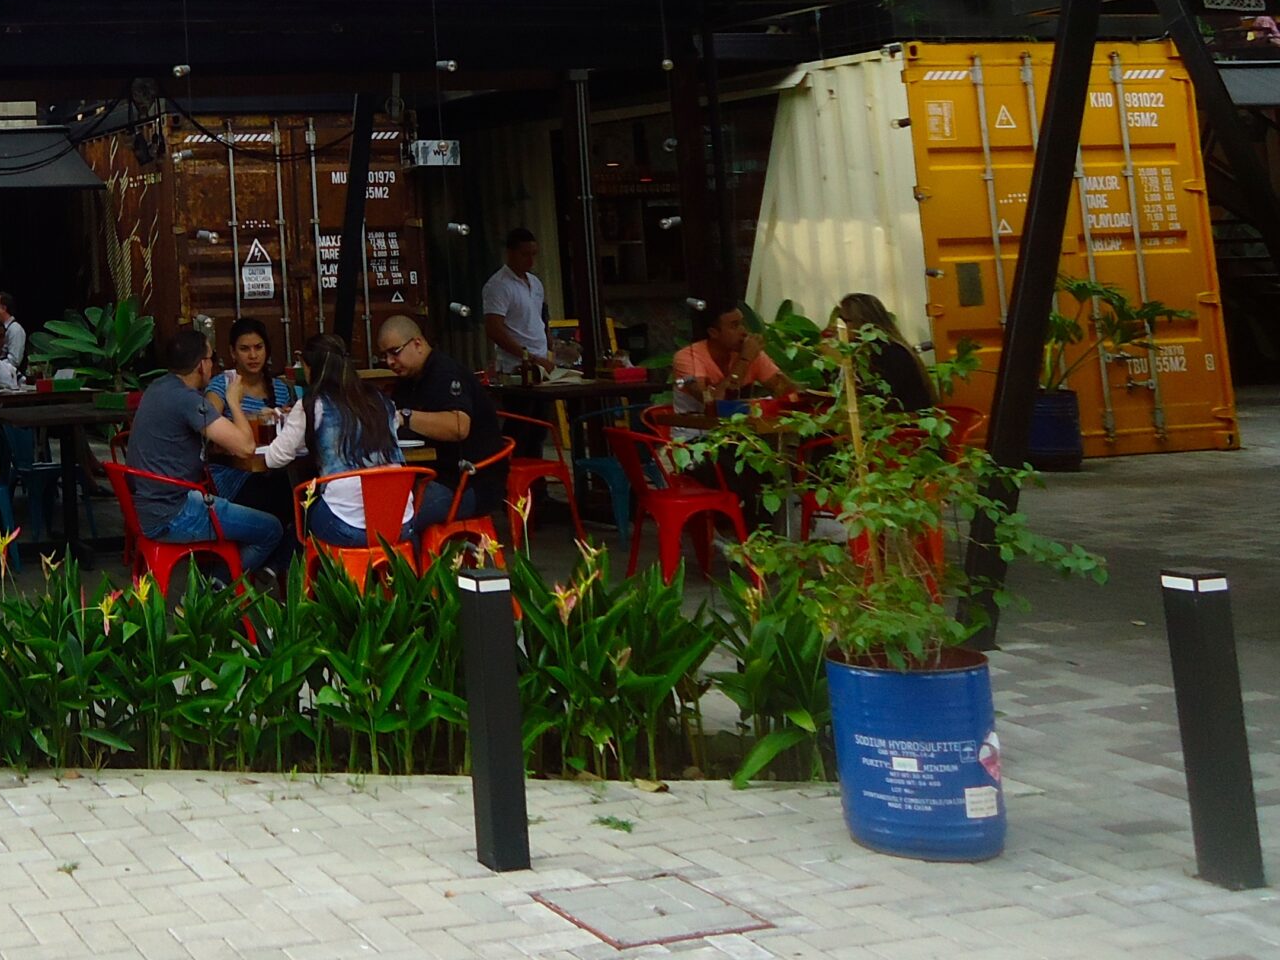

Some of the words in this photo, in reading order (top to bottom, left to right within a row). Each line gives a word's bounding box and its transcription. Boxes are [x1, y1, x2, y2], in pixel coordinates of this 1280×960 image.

[1089, 92, 1113, 107] KHO
[1125, 92, 1165, 107] 981022
[1127, 112, 1158, 127] 55M2
[331, 171, 349, 184] MU
[367, 171, 396, 183] 01979
[1085, 194, 1109, 209] TARE
[321, 249, 339, 260] TARE
[1126, 358, 1149, 375] TBU
[1155, 356, 1187, 372] 55M2
[855, 734, 886, 748] SODIUM
[888, 741, 960, 752] HYDROSULFITE
